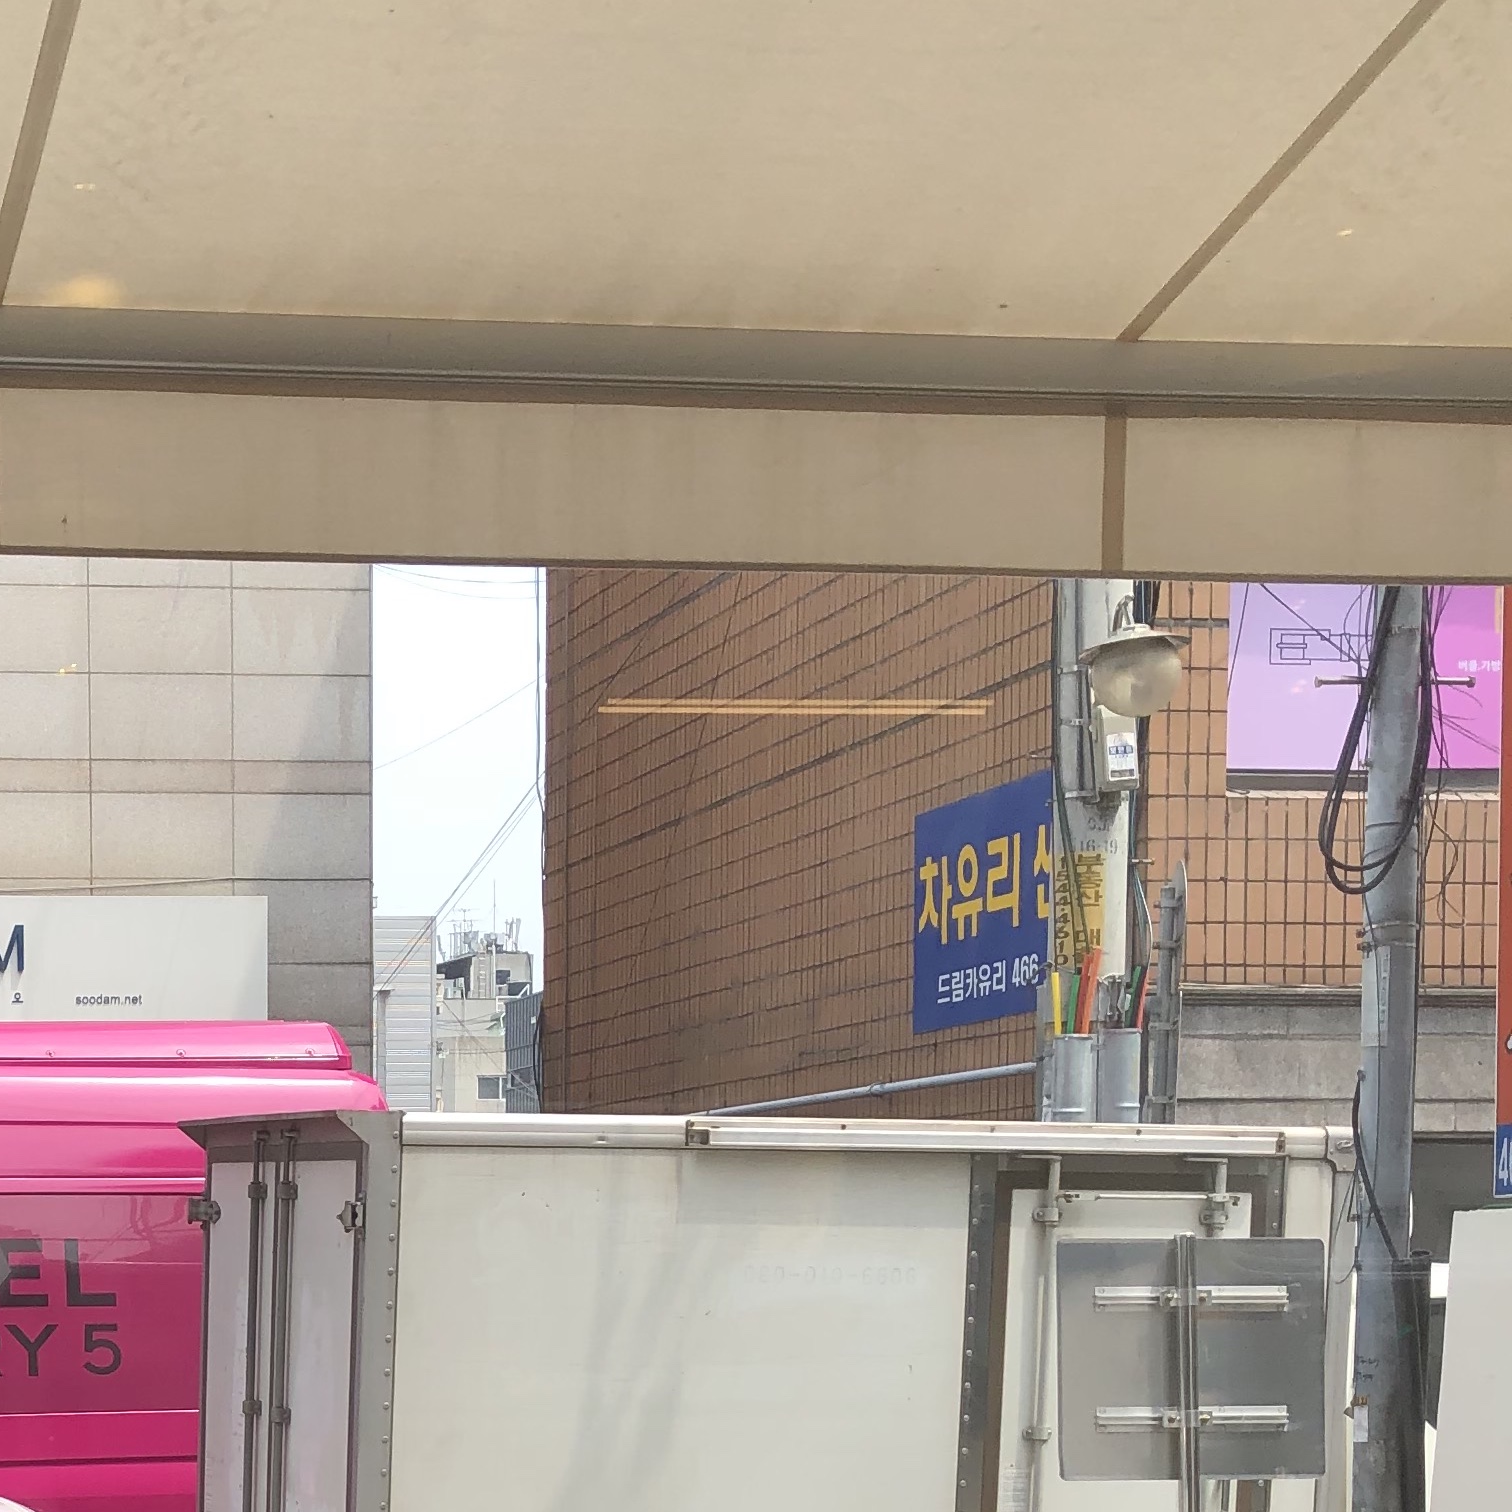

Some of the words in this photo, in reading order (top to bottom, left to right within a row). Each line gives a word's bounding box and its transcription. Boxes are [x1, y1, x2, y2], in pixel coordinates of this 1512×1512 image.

[918, 832, 1021, 945] 차유리
[75, 993, 143, 1006] soodam.net
[937, 959, 1007, 1004] 드림카유리
[82, 1323, 122, 1375] 5
